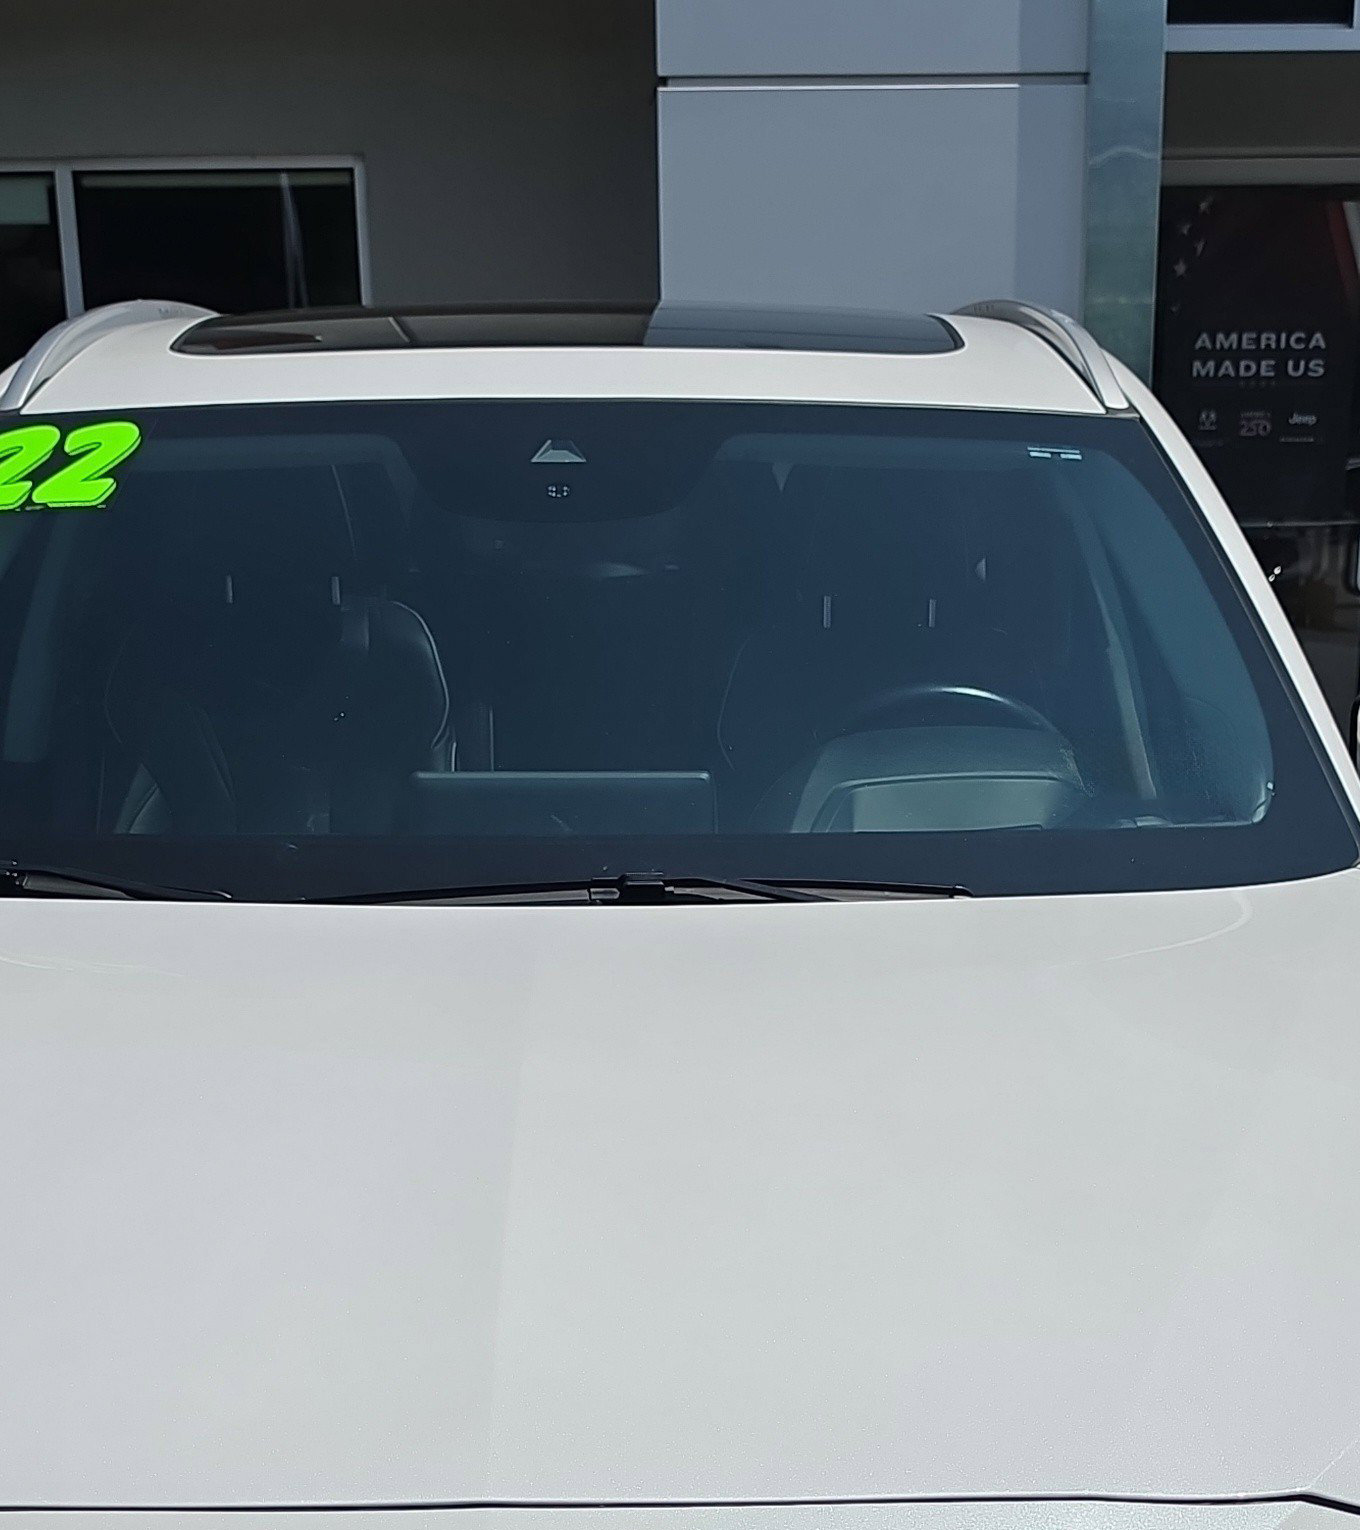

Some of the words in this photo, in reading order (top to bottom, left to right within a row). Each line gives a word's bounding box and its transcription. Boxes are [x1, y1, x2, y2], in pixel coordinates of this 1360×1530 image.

[1194, 332, 1326, 350] AMERICA
[1192, 359, 1276, 378] MADE
[1286, 359, 1325, 378] US
